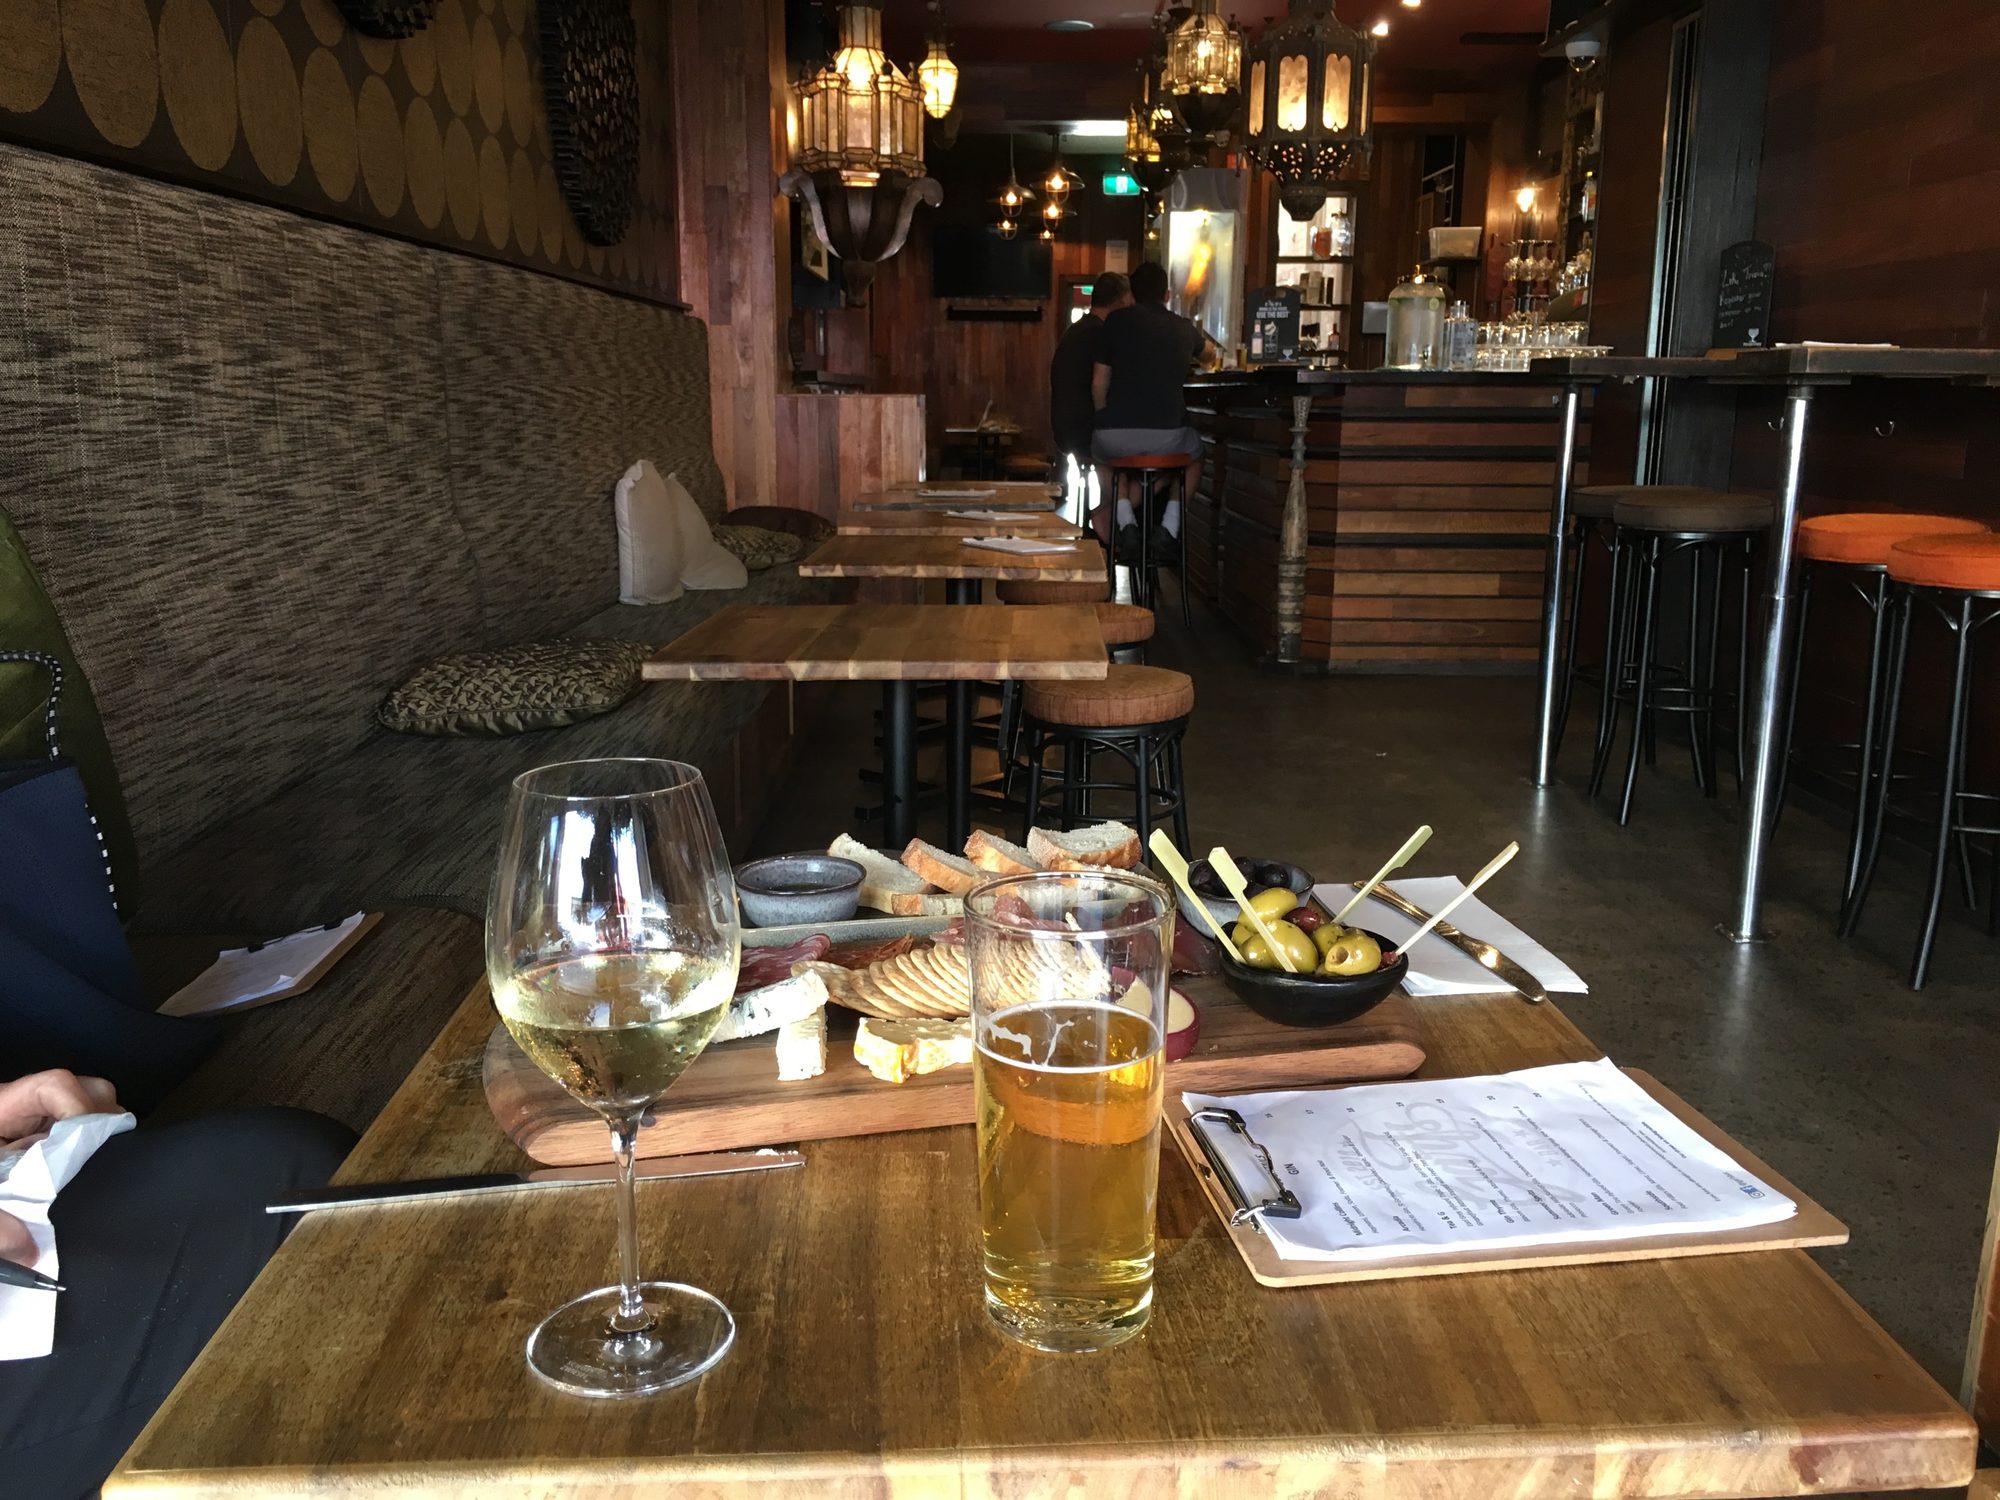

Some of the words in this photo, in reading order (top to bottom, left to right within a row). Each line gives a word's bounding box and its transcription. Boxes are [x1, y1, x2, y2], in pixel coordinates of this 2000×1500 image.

[1284, 1163, 1299, 1175] GIN
[1527, 1189, 1543, 1202] Spritz
[1590, 1192, 1604, 1202] Man
[1645, 1190, 1673, 1210] Southside
[1332, 1202, 1347, 1216] Collins
[1489, 1199, 1506, 1215] Thyme
[1539, 1202, 1562, 1220] Summer
[1601, 1202, 1619, 1215] Green
[1446, 1220, 1457, 1229] Tea
[1504, 1215, 1514, 1223] Gin
[1342, 1216, 1362, 1236] Midnight
